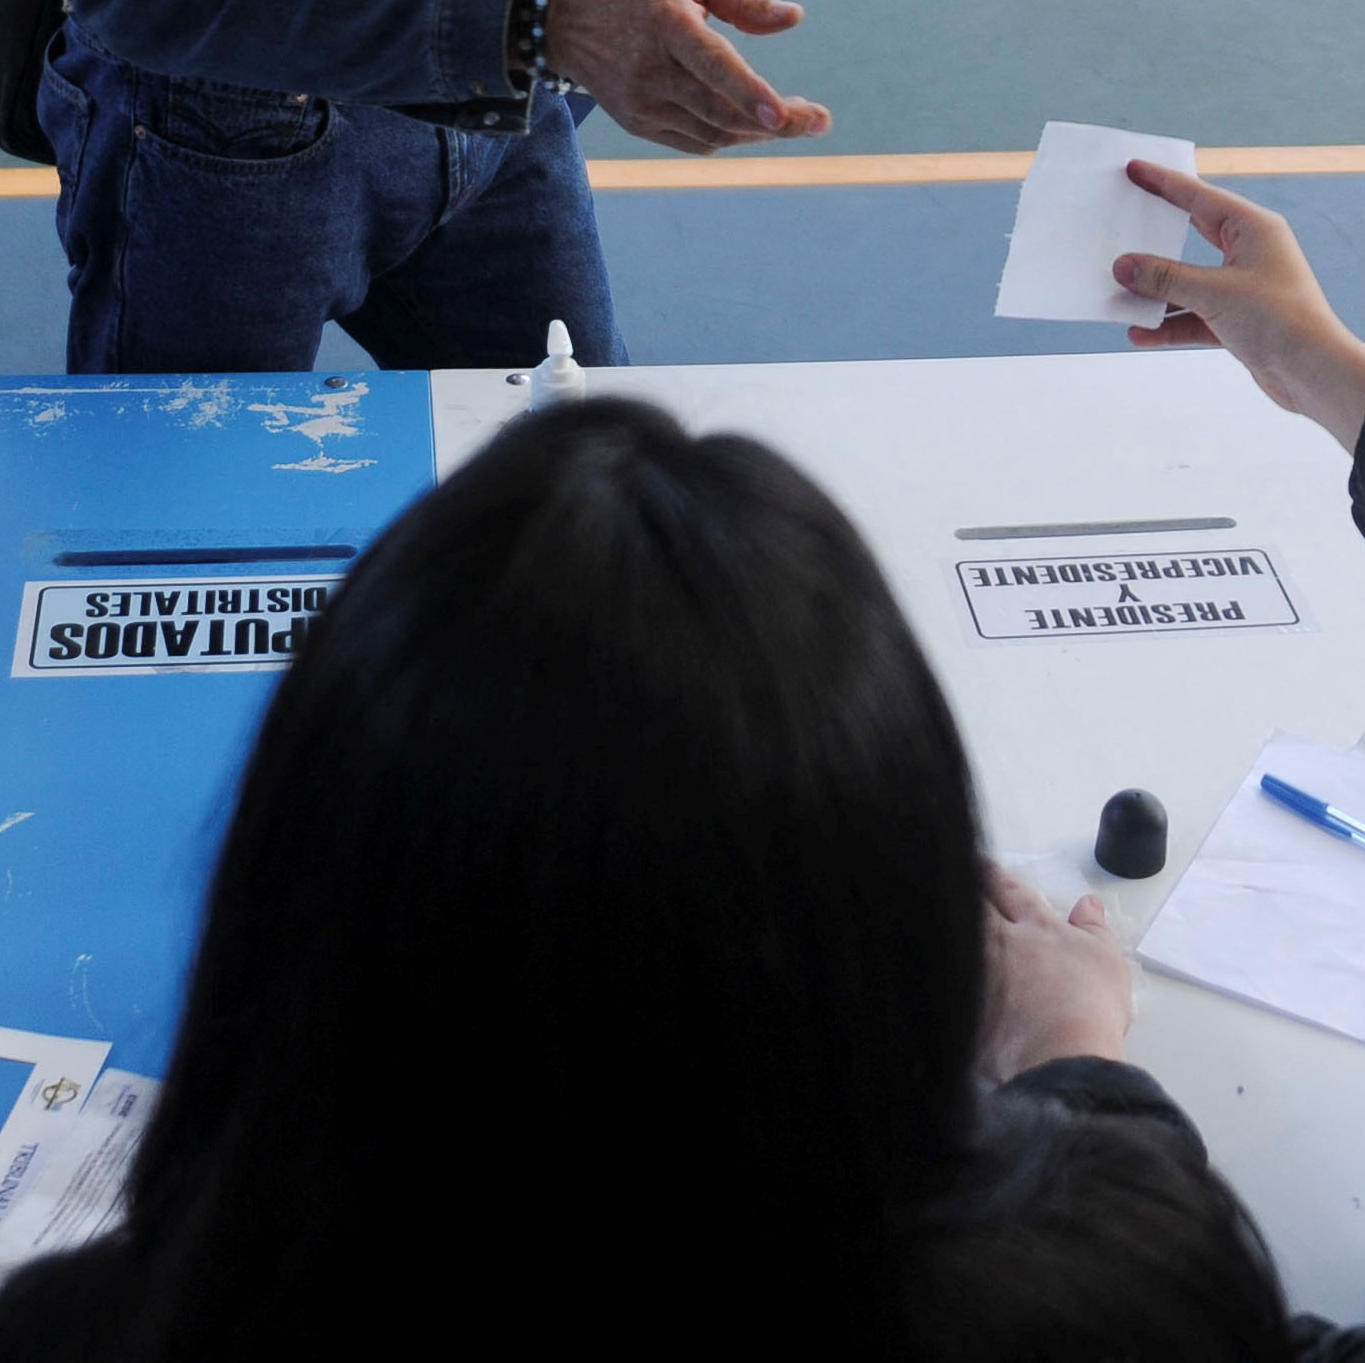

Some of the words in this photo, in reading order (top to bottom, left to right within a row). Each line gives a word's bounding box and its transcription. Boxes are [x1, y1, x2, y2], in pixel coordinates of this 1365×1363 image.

[969, 555, 1264, 587] VICEPRESIDENTE
[85, 586, 328, 617] DISTRITALES
[1118, 583, 1142, 603] Y
[1026, 600, 1246, 630] PRESIDENTE
[48, 616, 317, 660] PUTADOS
